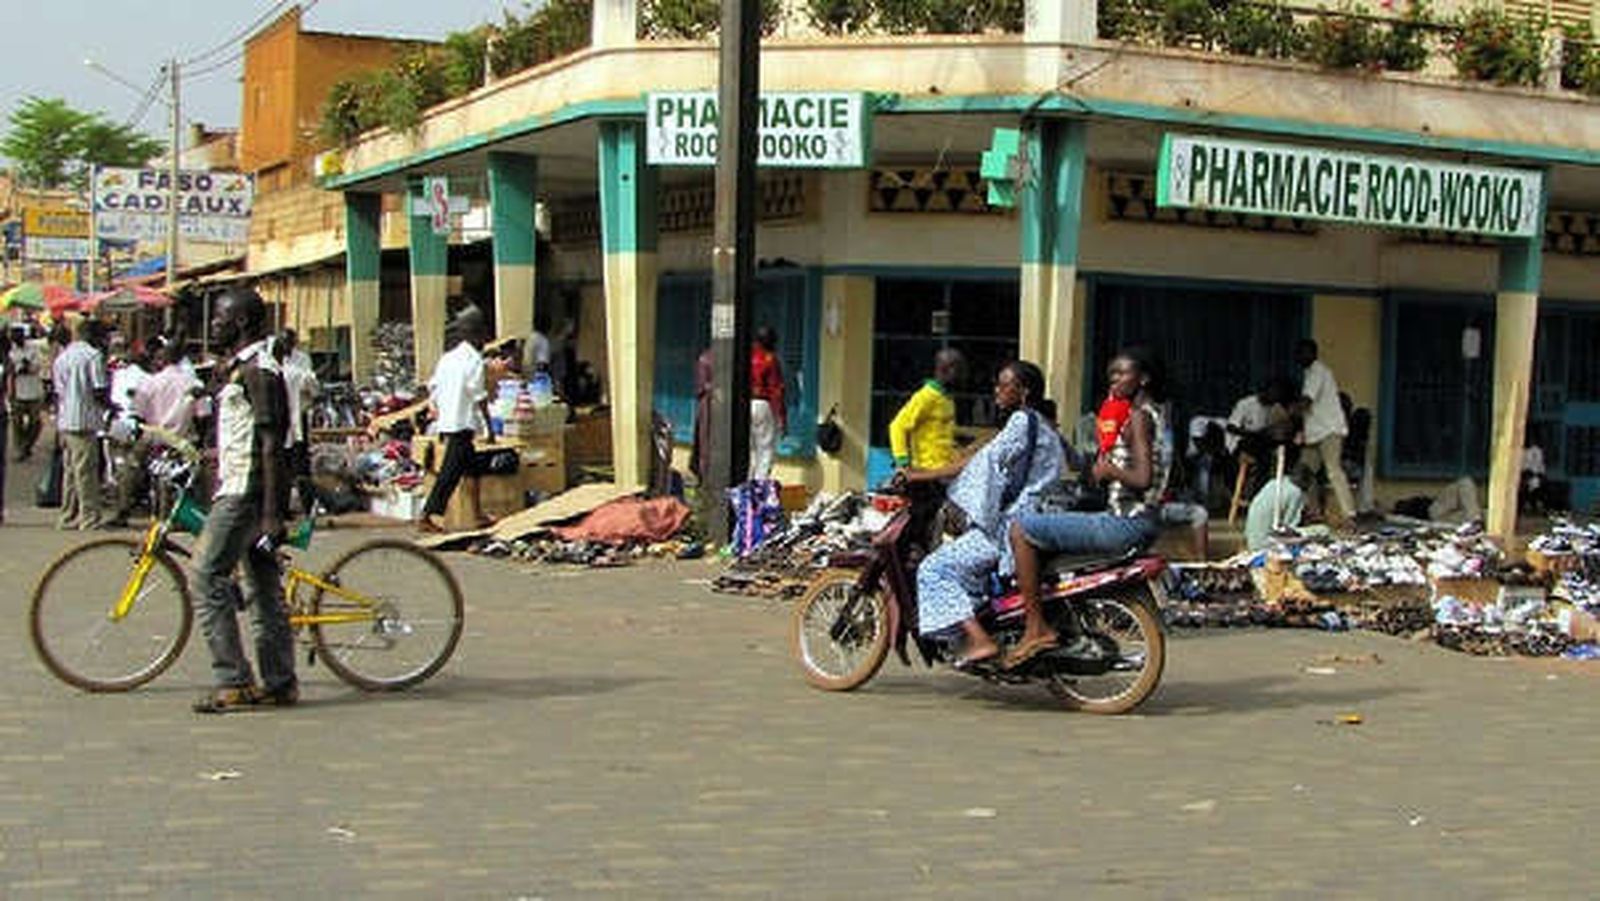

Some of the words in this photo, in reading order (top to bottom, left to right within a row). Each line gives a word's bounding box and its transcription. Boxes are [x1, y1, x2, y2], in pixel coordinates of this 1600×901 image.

[656, 98, 849, 128] PHAACIE
[138, 172, 213, 191] FASO
[1189, 145, 1361, 218] PHARMACIE
[1366, 163, 1523, 232] ROOD-WOOKO
